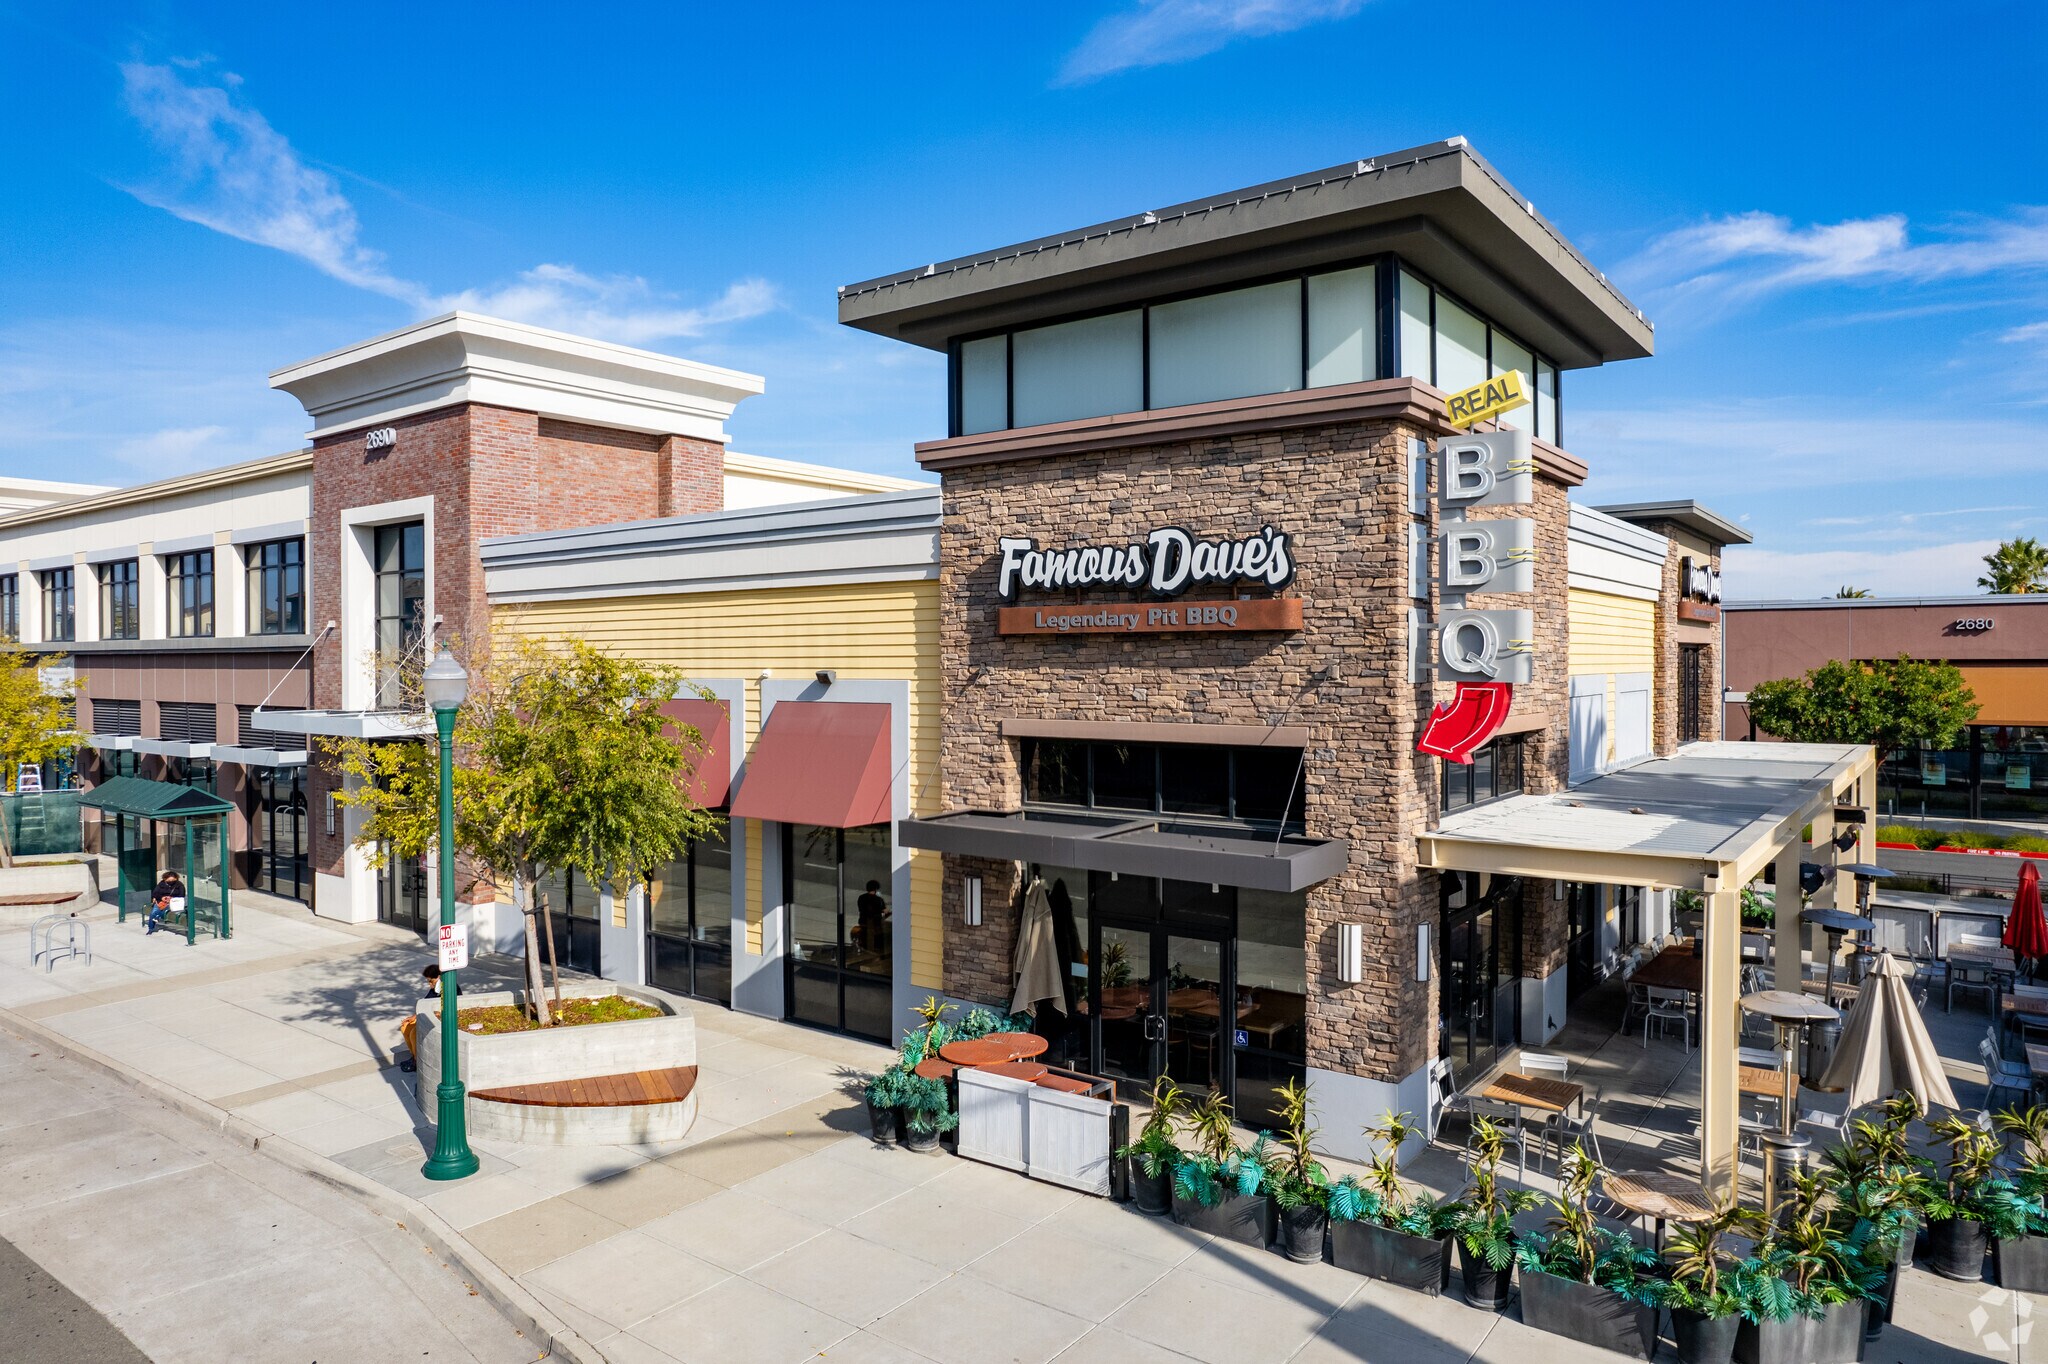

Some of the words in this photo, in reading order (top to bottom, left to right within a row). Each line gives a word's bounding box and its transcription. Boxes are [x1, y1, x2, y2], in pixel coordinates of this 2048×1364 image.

[1449, 378, 1519, 420] REAL
[366, 427, 394, 450] 2690
[998, 536, 1146, 598] Famous
[1149, 525, 1291, 591] Dave's
[1035, 609, 1140, 630] Legendary
[1148, 607, 1179, 626] Pit
[1186, 605, 1238, 627] BBQ
[1955, 617, 1995, 630] 2680
[440, 928, 451, 939] NO
[441, 939, 465, 949] PARKING
